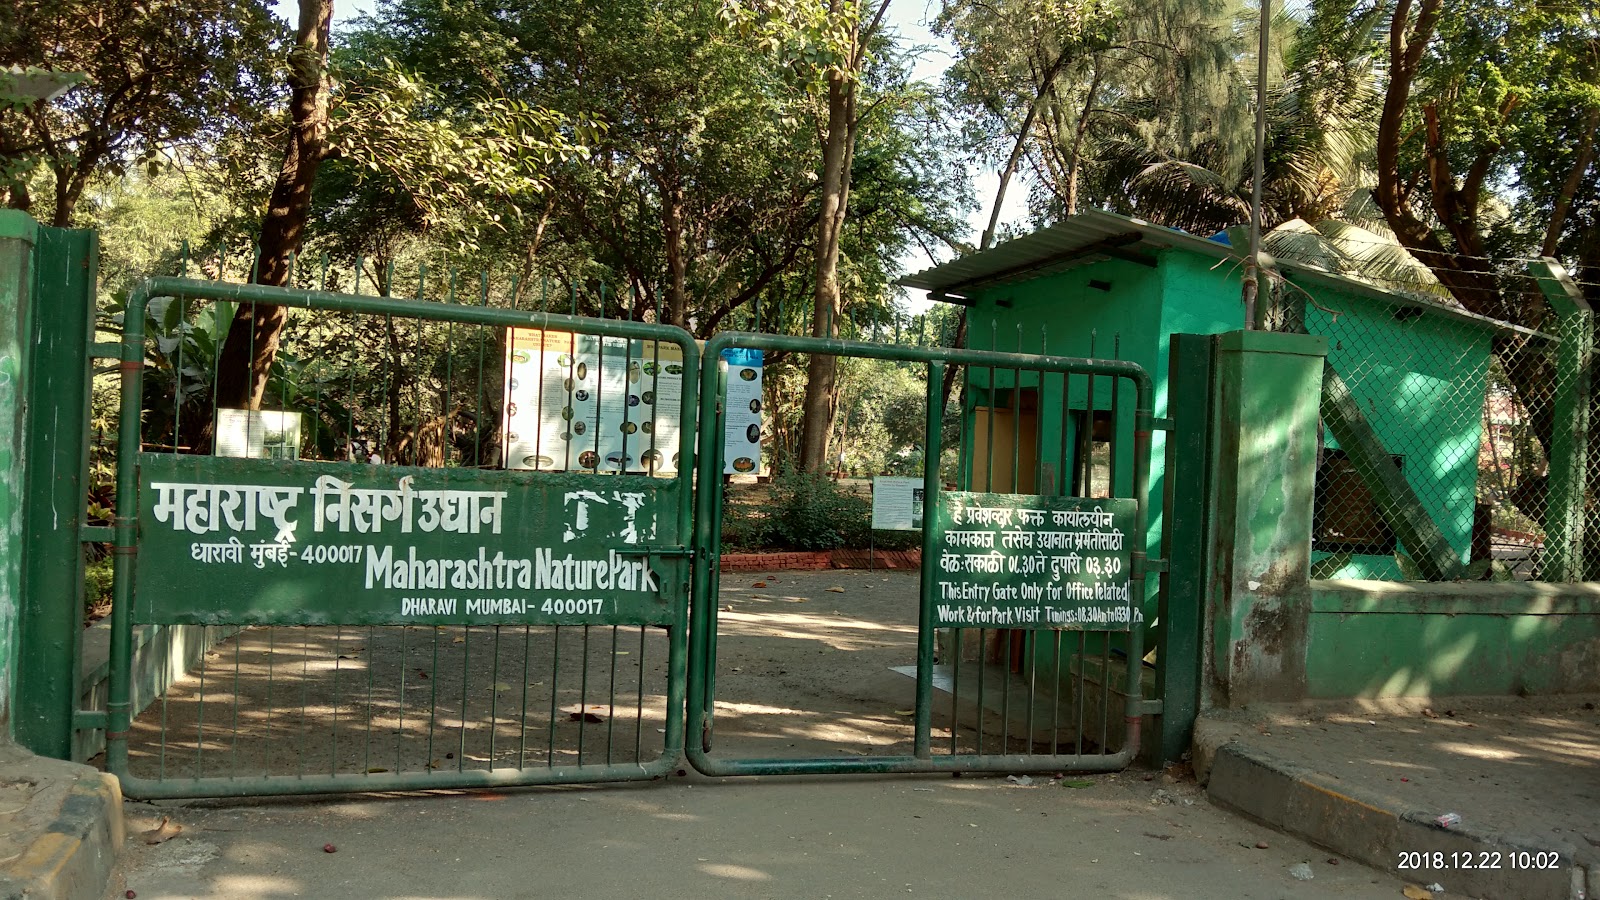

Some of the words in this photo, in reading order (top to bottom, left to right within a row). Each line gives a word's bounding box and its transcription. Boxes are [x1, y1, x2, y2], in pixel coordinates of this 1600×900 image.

[150, 481, 304, 543] महाराष्ट्र
[310, 474, 417, 533] निसर्ग
[1017, 508, 1047, 528] फक्त
[191, 536, 245, 564] धारावी
[300, 544, 363, 564] 400017
[944, 530, 996, 549] कामकाज
[1001, 525, 1035, 550] तसेच
[365, 545, 531, 591] Maharashtra
[1050, 551, 1082, 582] दुपारी
[938, 581, 961, 600] This
[962, 581, 990, 603] Entry
[992, 581, 1018, 601] Gate
[1021, 581, 1044, 604] Only
[1046, 581, 1062, 601] for
[1066, 581, 1093, 601] Office
[401, 597, 457, 616] DHARAVI
[541, 597, 603, 616] 400017
[937, 604, 965, 623] Work
[1014, 605, 1041, 623] Visit
